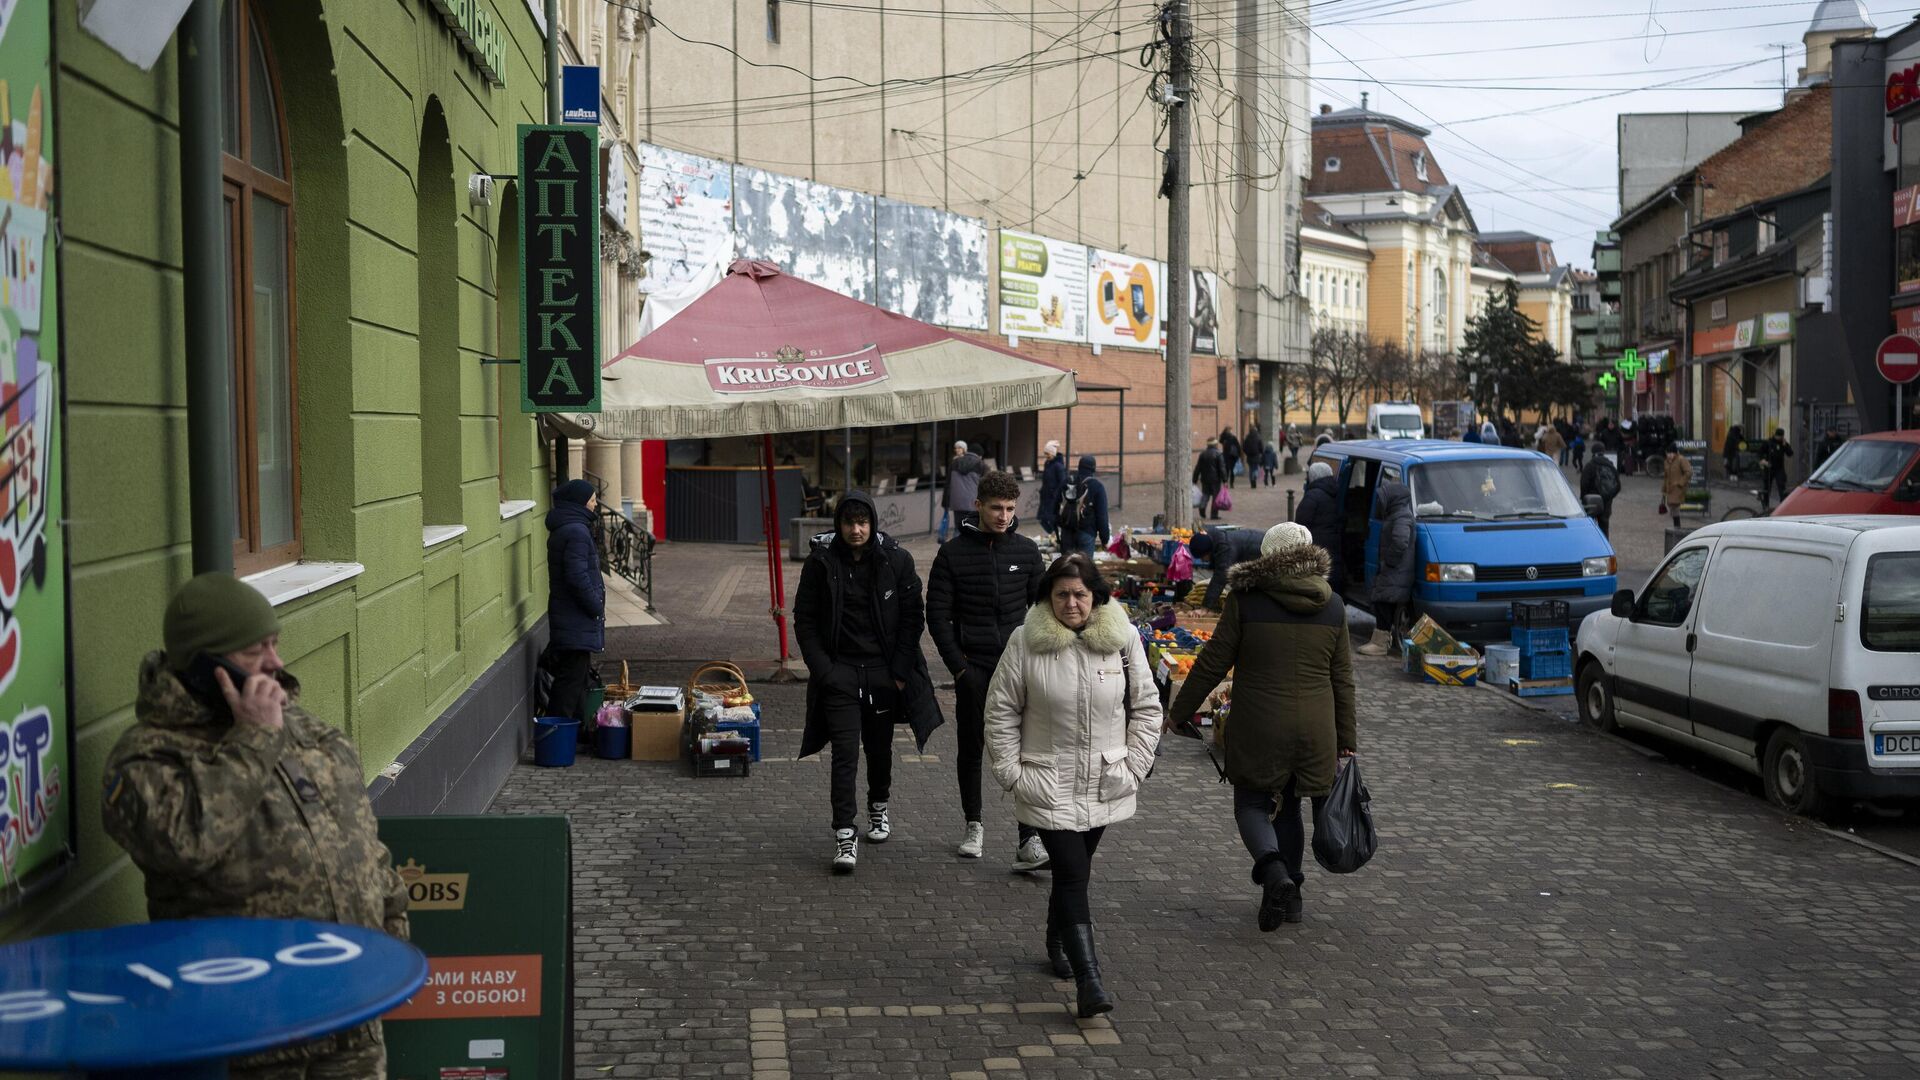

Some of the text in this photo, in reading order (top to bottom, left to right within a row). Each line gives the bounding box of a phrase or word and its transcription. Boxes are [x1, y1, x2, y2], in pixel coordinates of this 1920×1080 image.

[534, 134, 582, 396] АПТЕКА
[717, 359, 876, 385] KRUŠOVICE
[599, 408, 667, 436] ЧРЕЗМЕРНОЕ
[674, 404, 752, 436] УПОТРЕБЛЕНИЕ
[760, 397, 833, 431] АЛКОГОЛЬНОЙ
[900, 393, 937, 419] ВРЕДИТ
[944, 387, 985, 415] ВАШЕМУ
[992, 382, 1043, 412] ЗДОРОВЬЮ
[403, 882, 460, 902] OBS
[471, 970, 517, 985] КАВУ
[452, 988, 526, 1004] СОБОЮ!
